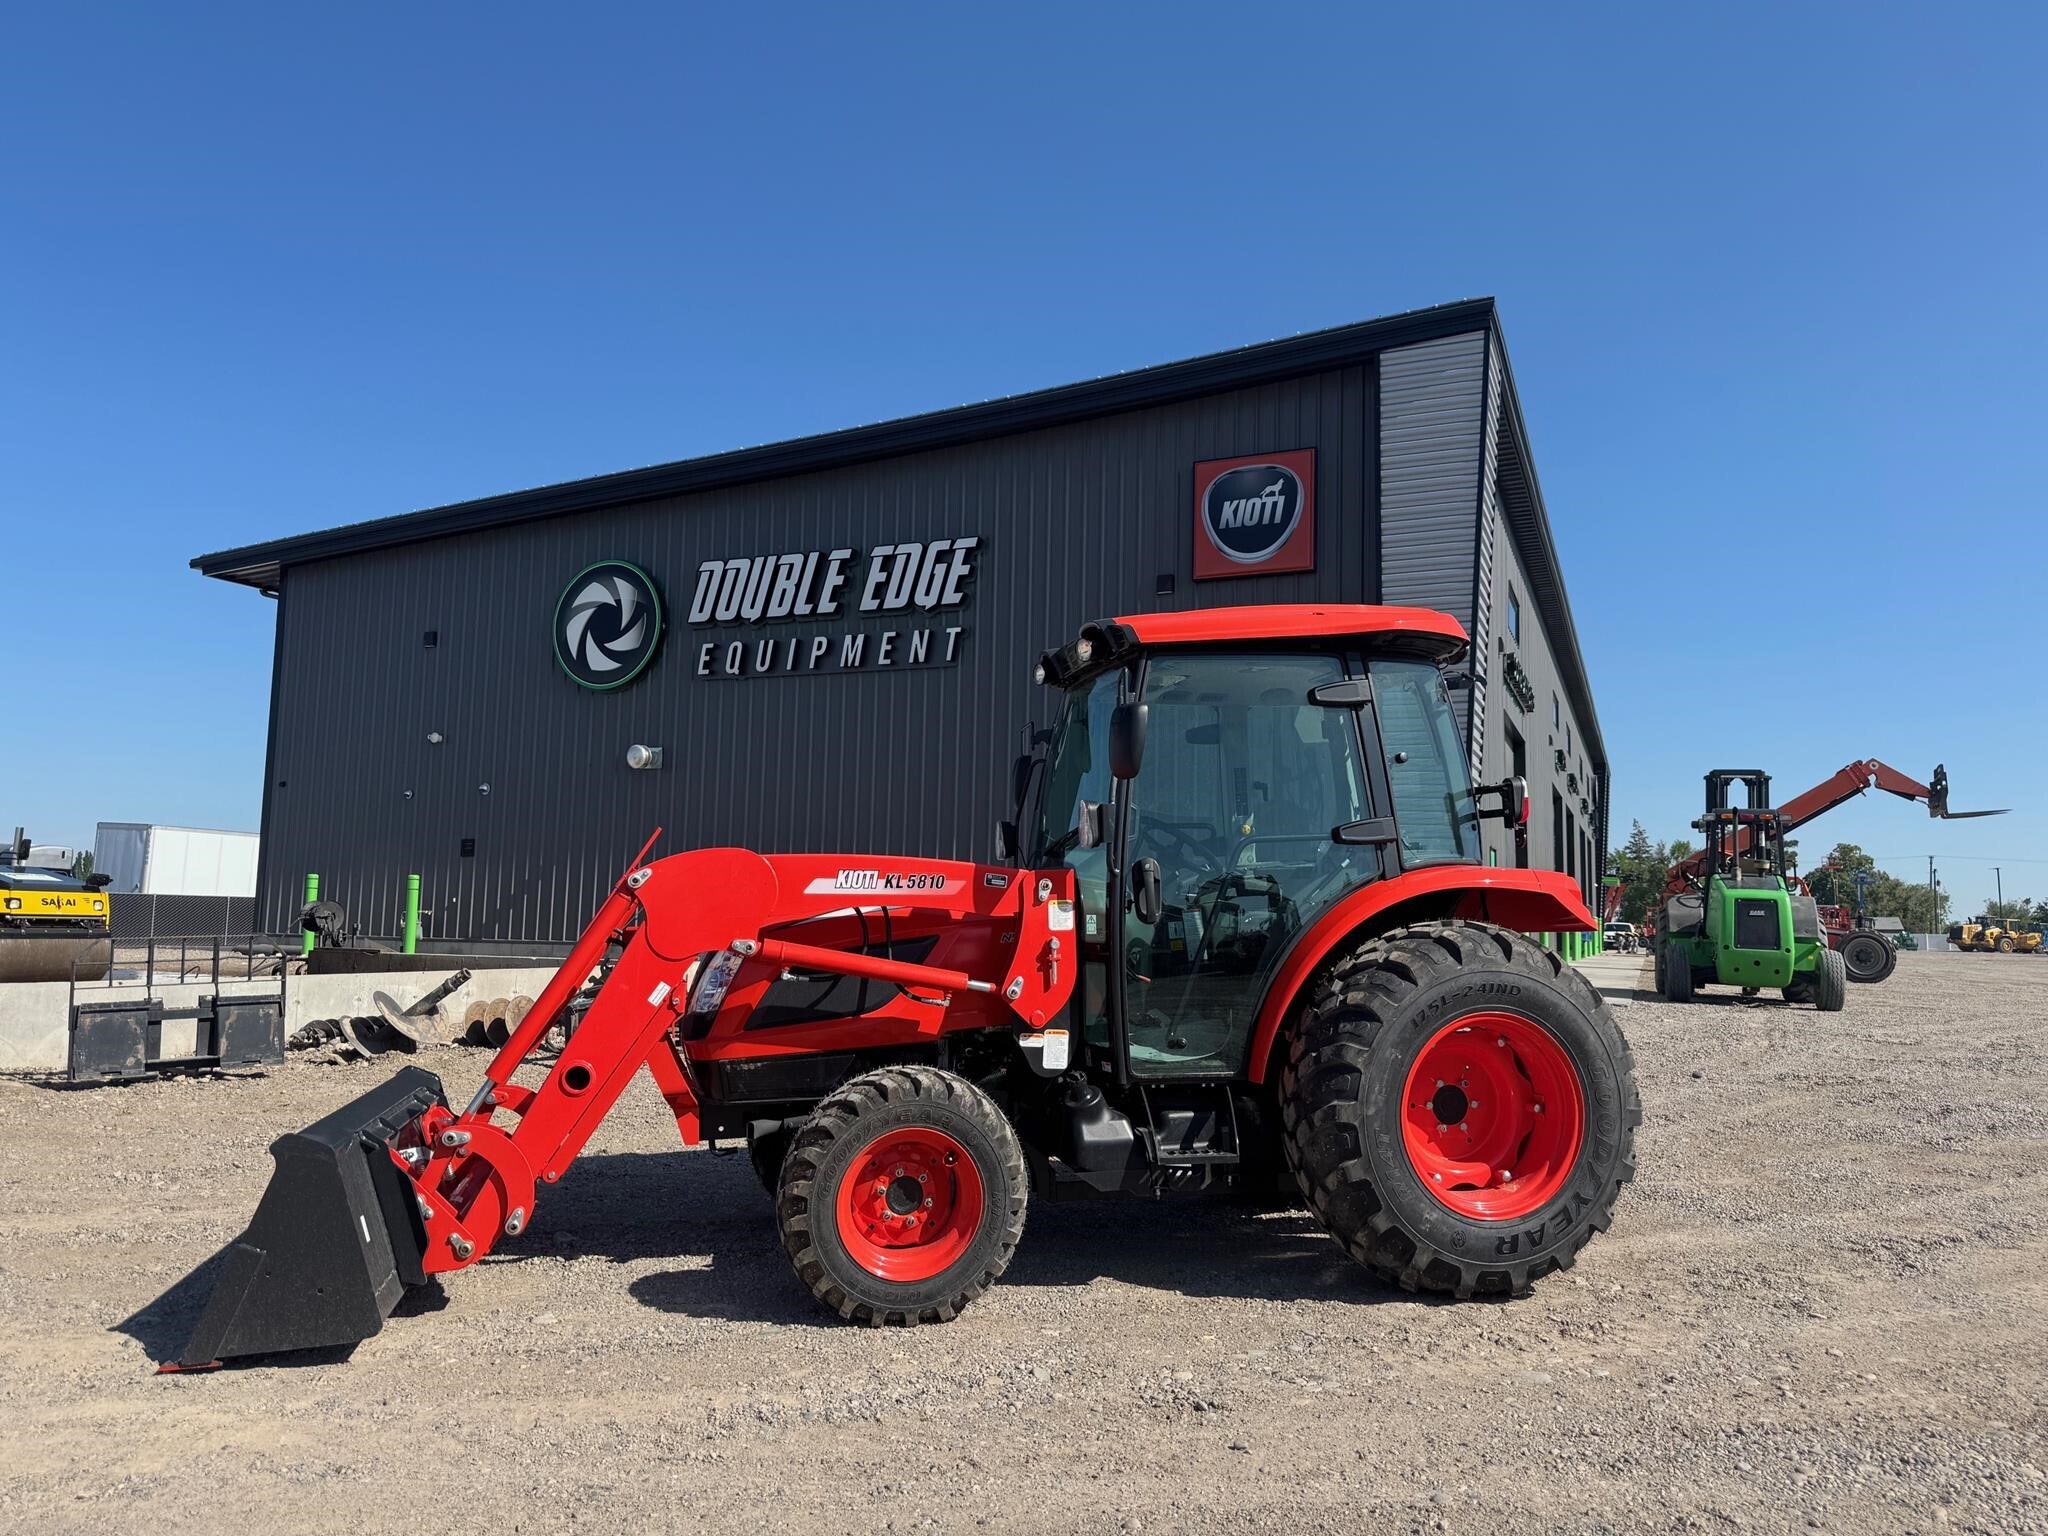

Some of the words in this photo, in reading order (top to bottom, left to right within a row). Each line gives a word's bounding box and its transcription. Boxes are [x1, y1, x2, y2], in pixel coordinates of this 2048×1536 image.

[1218, 495, 1285, 529] KIOTI
[687, 548, 852, 625] DOUBLE
[858, 537, 979, 612] EDGE
[697, 627, 962, 675] EQUIPMENT
[834, 869, 880, 890] KIOTI
